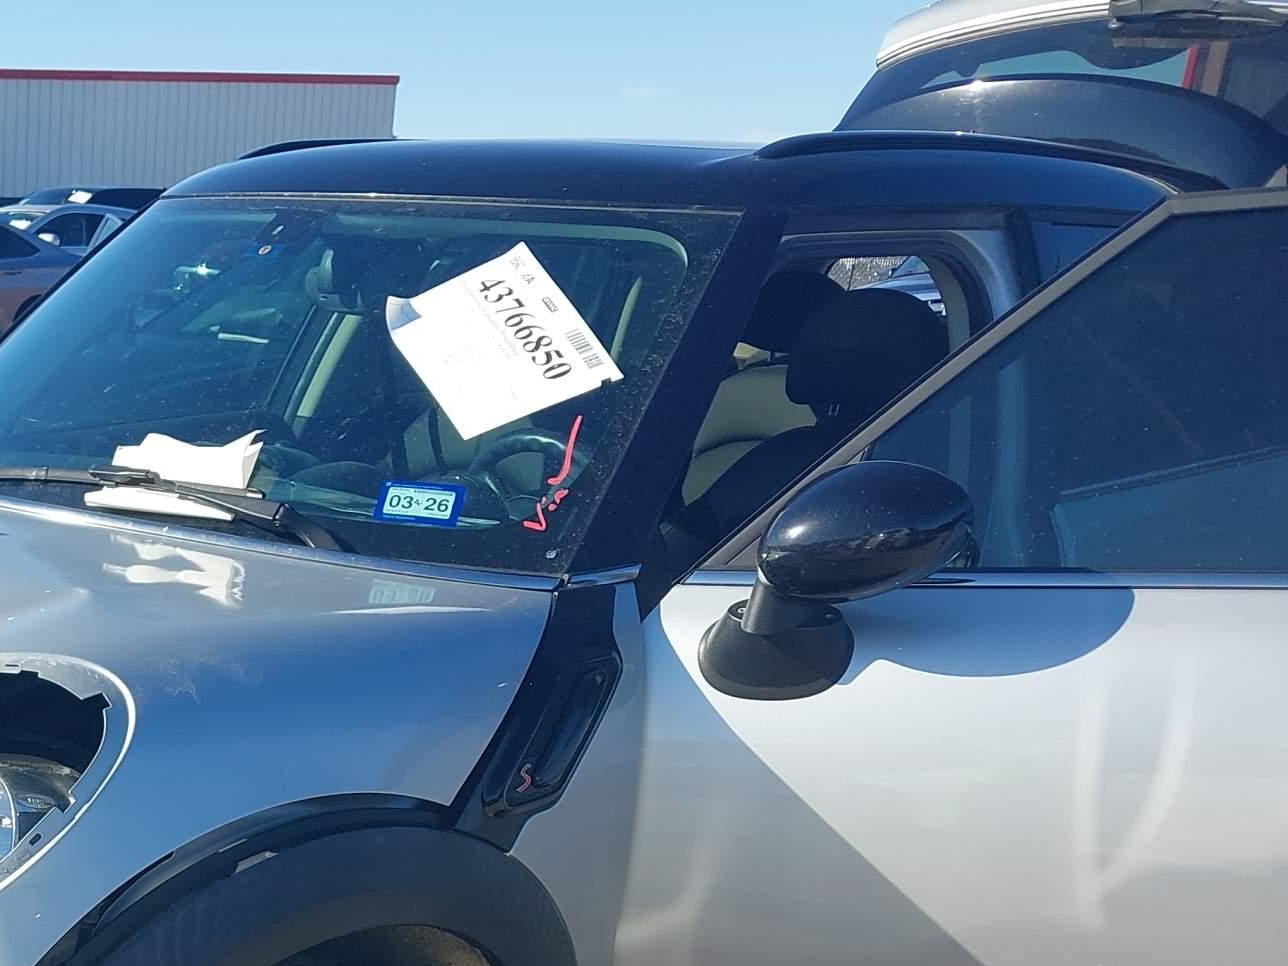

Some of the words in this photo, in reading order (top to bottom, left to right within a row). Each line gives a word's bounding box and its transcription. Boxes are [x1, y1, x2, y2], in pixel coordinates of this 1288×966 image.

[479, 279, 572, 380] 43766850
[389, 494, 414, 509] 03
[424, 497, 450, 513] 26
